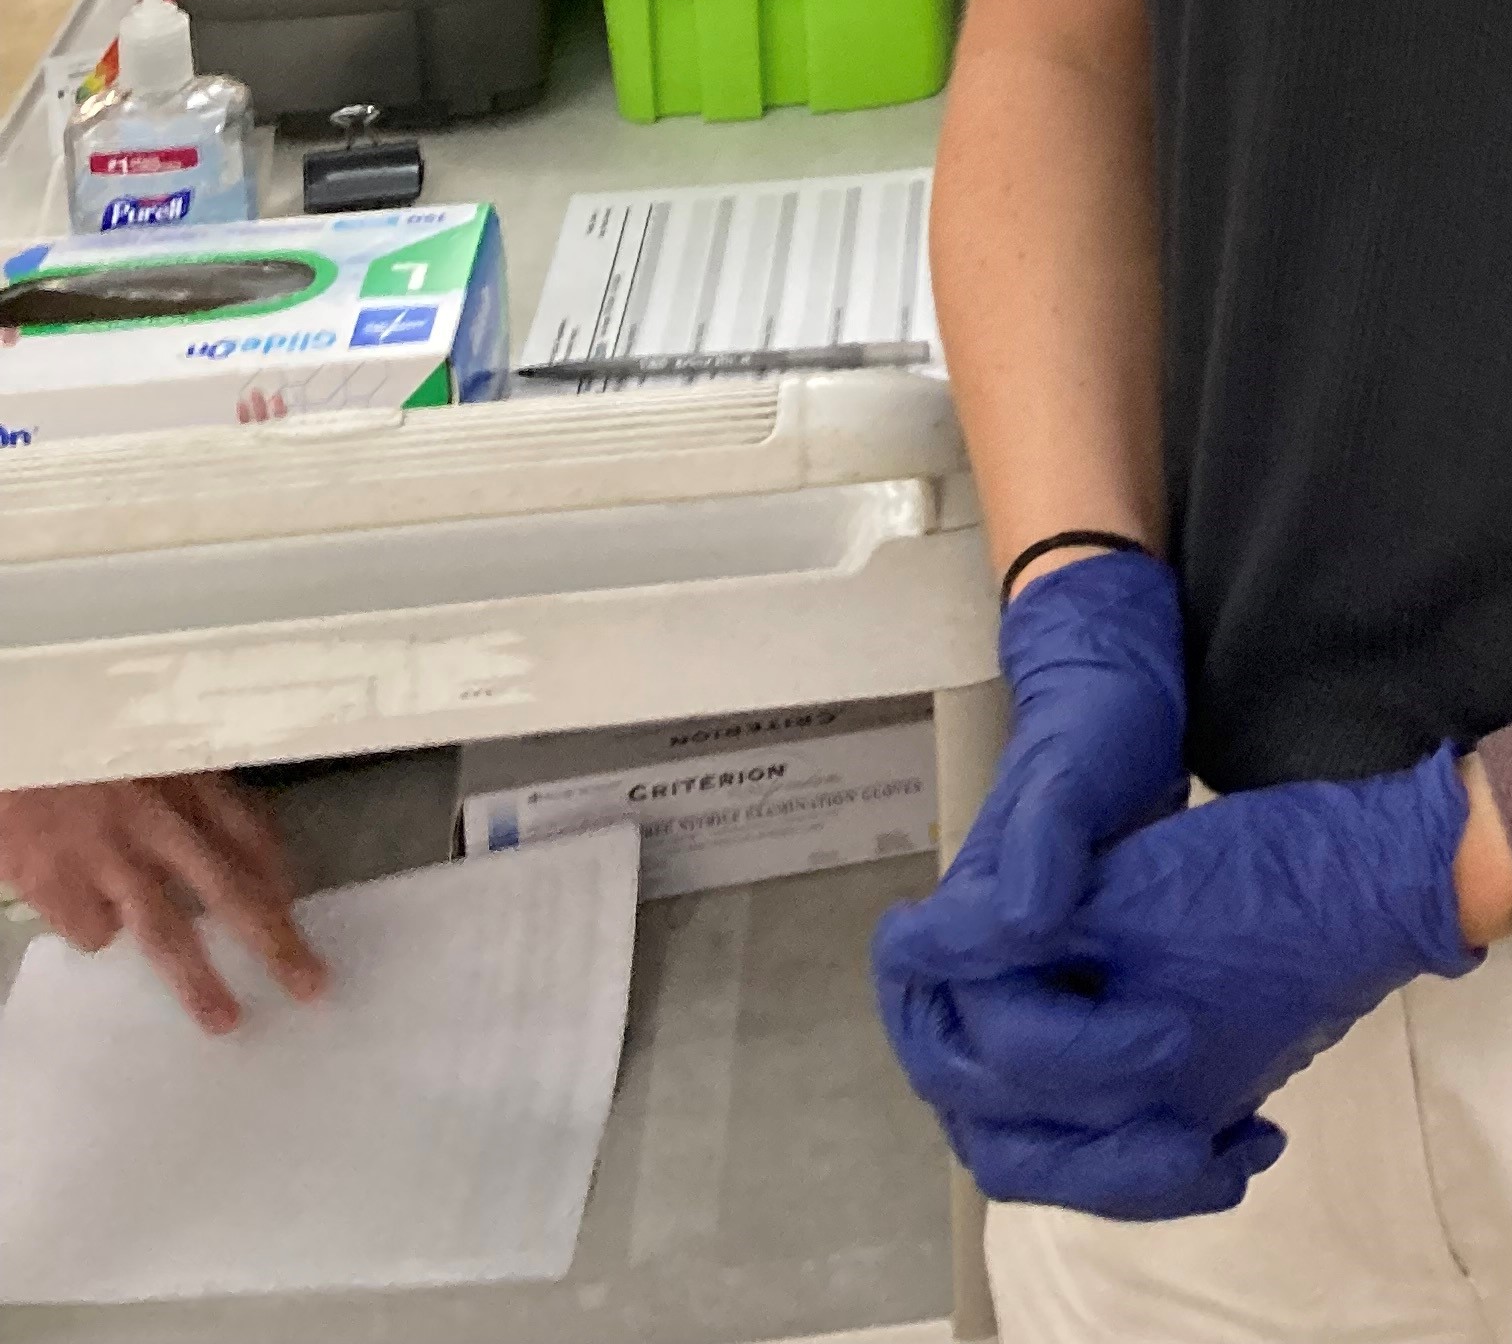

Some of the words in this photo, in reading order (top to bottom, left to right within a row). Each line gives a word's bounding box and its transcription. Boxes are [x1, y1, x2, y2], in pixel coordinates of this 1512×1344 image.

[109, 196, 184, 227] Purell
[391, 262, 429, 292] L
[627, 763, 787, 803] CRITERION
